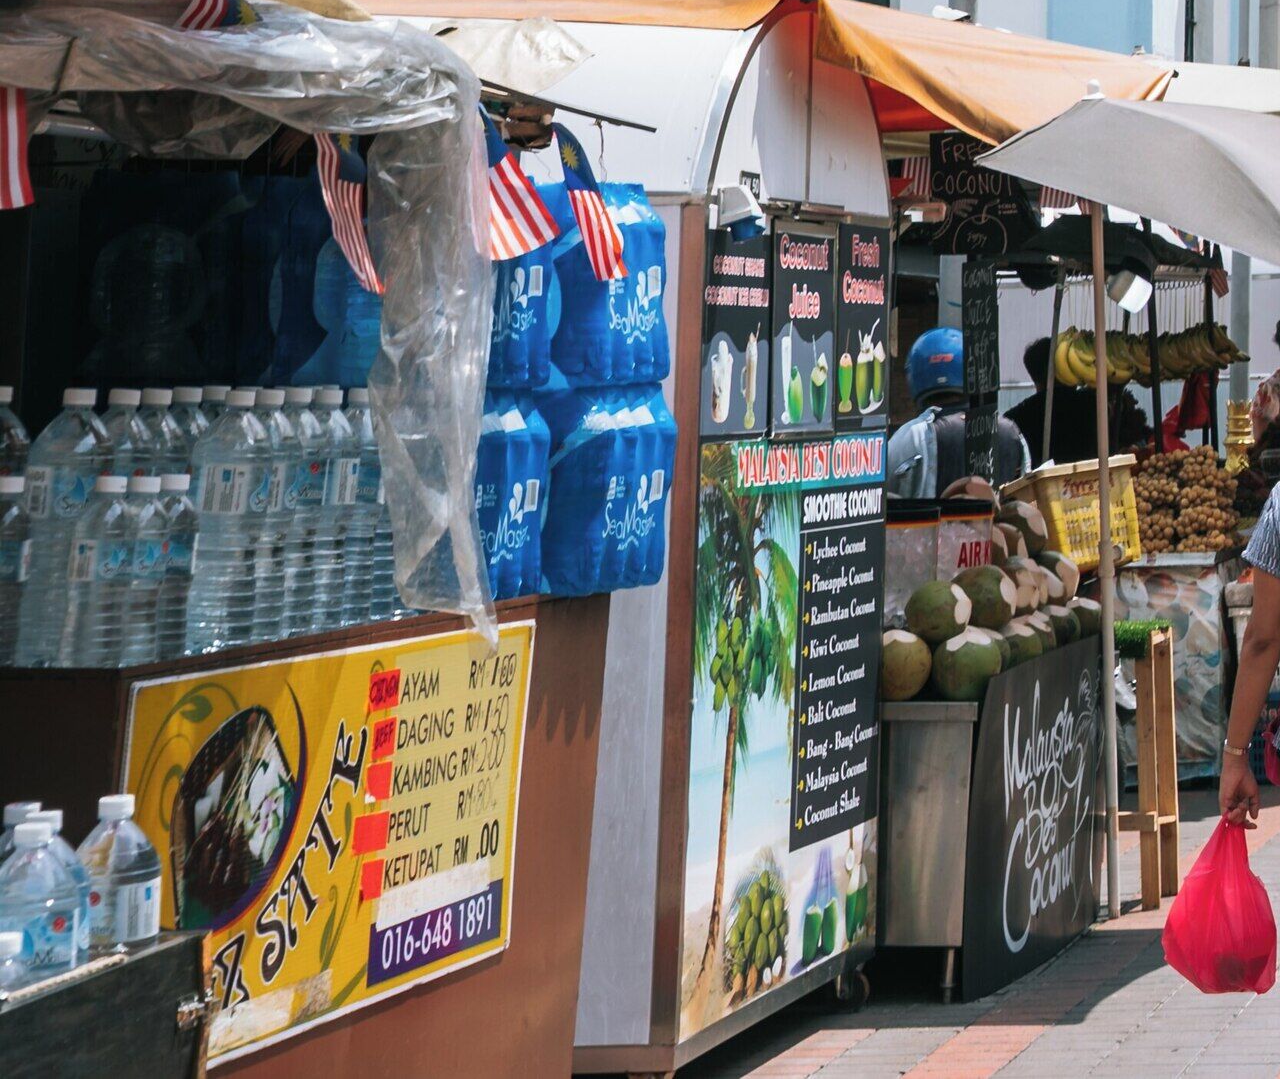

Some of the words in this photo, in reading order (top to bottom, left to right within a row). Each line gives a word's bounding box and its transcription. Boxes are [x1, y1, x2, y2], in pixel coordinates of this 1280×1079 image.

[780, 233, 830, 272] Coconut
[851, 233, 880, 269] Fresh
[788, 283, 821, 320] Juice
[842, 270, 885, 306] Coconut
[737, 442, 800, 488] MALAYSIA
[802, 440, 832, 483] BEST
[832, 436, 883, 479] COCONUT
[803, 491, 847, 524] SMOOTHIE
[848, 487, 883, 518] COCONUT
[812, 536, 839, 564] Lychee
[840, 536, 866, 556] Coconut
[957, 540, 982, 569] AIR
[812, 566, 848, 595] Pineapple
[849, 567, 874, 585] Coconut
[810, 600, 849, 626] Rambutan
[850, 597, 876, 616] Coconut
[809, 638, 828, 660] Kiwi
[829, 633, 860, 655] Coconut
[400, 668, 440, 705] AYAM
[468, 659, 486, 690] RM
[808, 671, 836, 693] Lemon
[837, 663, 865, 685] Coconut
[396, 707, 455, 751] DAGING
[808, 699, 824, 726] Bali
[825, 697, 857, 720] Coconut
[806, 737, 828, 760] Bang
[834, 729, 854, 751] Bang
[1003, 679, 1078, 822] Malaysia
[392, 750, 458, 797] KAMBING
[805, 766, 840, 794] Malaysia
[840, 757, 868, 779] Coconut
[388, 802, 432, 844] PERUT
[804, 799, 838, 827] Coconut
[839, 787, 861, 814] Shake
[256, 719, 368, 986] SATE
[383, 842, 443, 890] KETUPAT
[453, 835, 469, 867] RM
[1002, 817, 1078, 953] Coconut
[381, 906, 453, 970] 016-648
[458, 892, 493, 940] 1891
